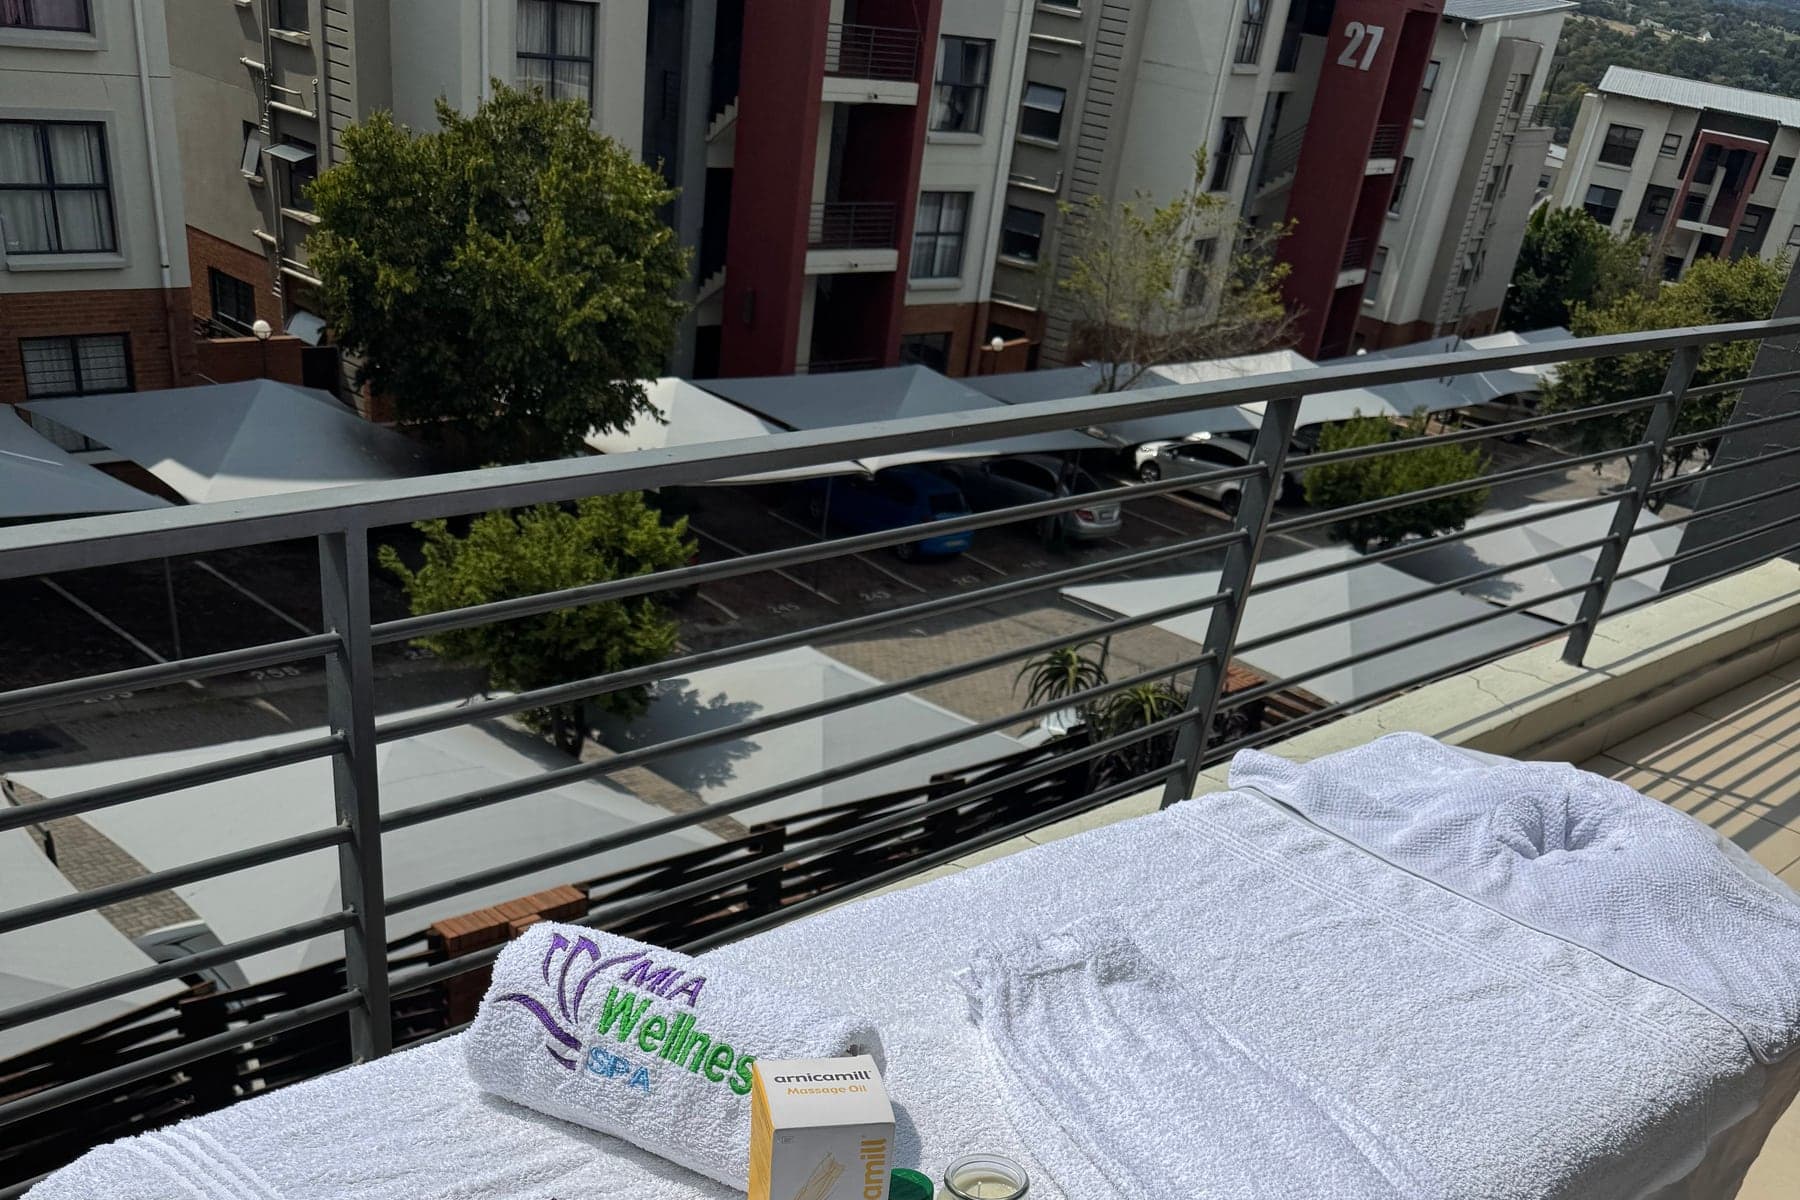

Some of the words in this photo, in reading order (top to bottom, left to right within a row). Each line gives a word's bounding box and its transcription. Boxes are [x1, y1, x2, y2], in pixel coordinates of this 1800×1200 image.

[1337, 21, 1384, 71] 27
[624, 957, 707, 1008] MIA
[599, 986, 755, 1096] Wellnes
[586, 1046, 650, 1092] SPA
[774, 1070, 870, 1083] arnicamill
[787, 1086, 846, 1096] Massage
[848, 1085, 867, 1093] Oil
